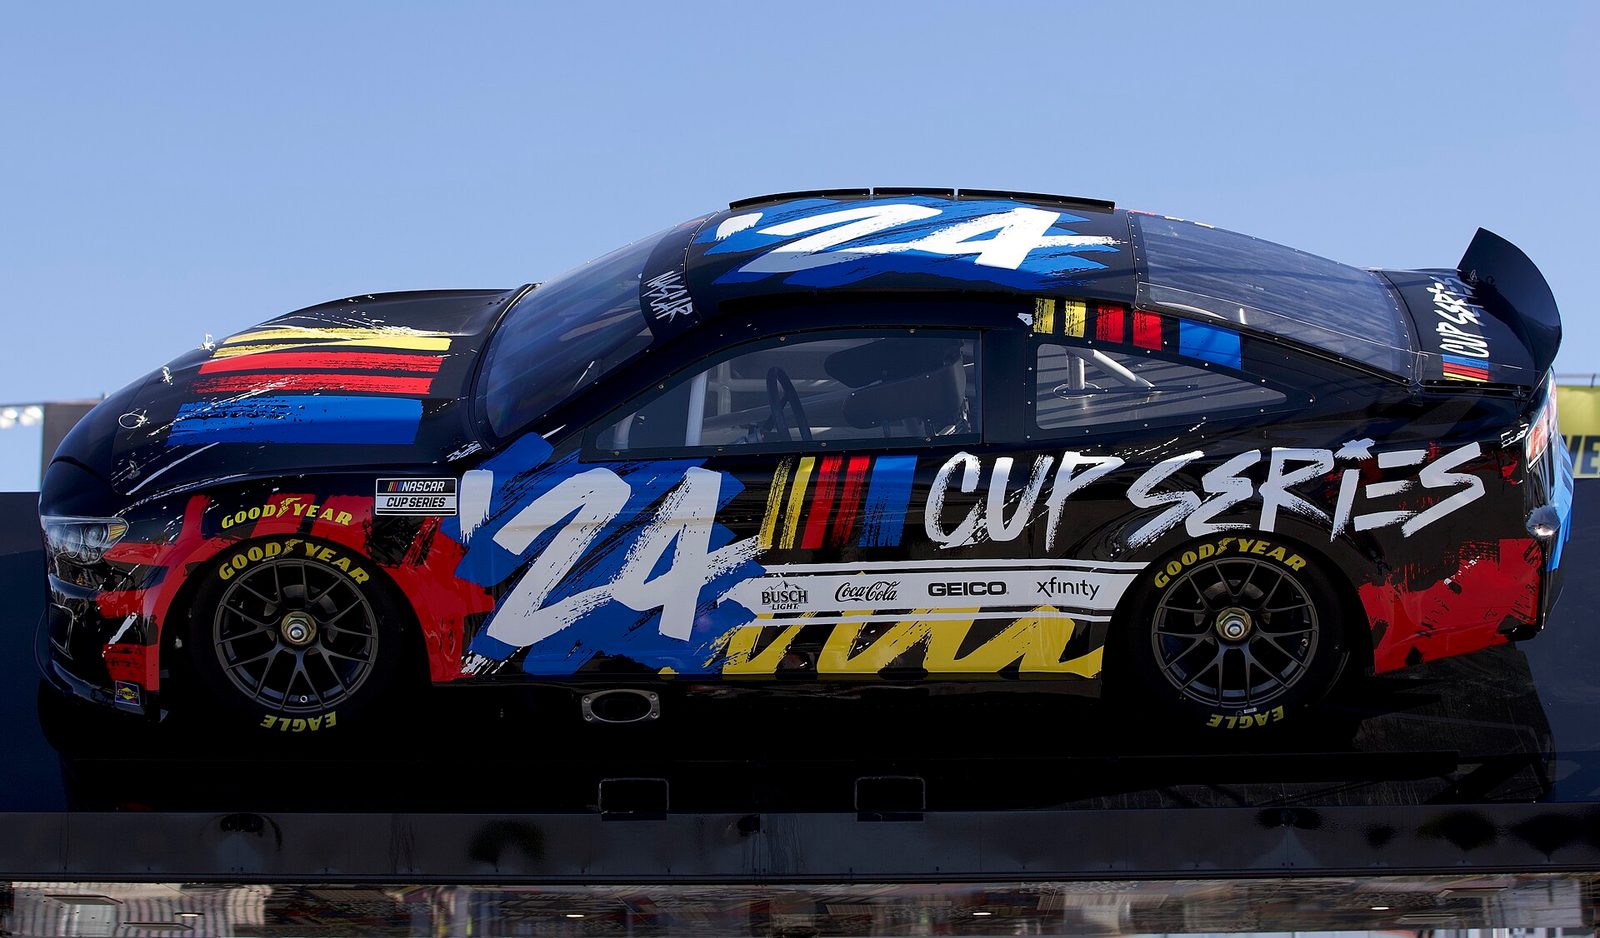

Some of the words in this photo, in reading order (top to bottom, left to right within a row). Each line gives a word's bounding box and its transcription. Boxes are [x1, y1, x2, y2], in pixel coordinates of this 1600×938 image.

[641, 270, 693, 323] NASCAR
[1435, 321, 1491, 358] CUP
[401, 480, 445, 493] NASCAR
[924, 450, 1124, 552] CUP
[1122, 439, 1486, 549] SERIES
[386, 496, 408, 508] CUP
[408, 496, 447, 508] SERIES
[761, 590, 808, 605] BUSCH
[834, 580, 901, 602] Coca-Cola
[927, 581, 1008, 597] GEICO
[1036, 576, 1101, 601] xfinity
[771, 603, 798, 611] LIGHT
[259, 711, 337, 732] EAGLE
[1206, 705, 1284, 729] EAGLE
